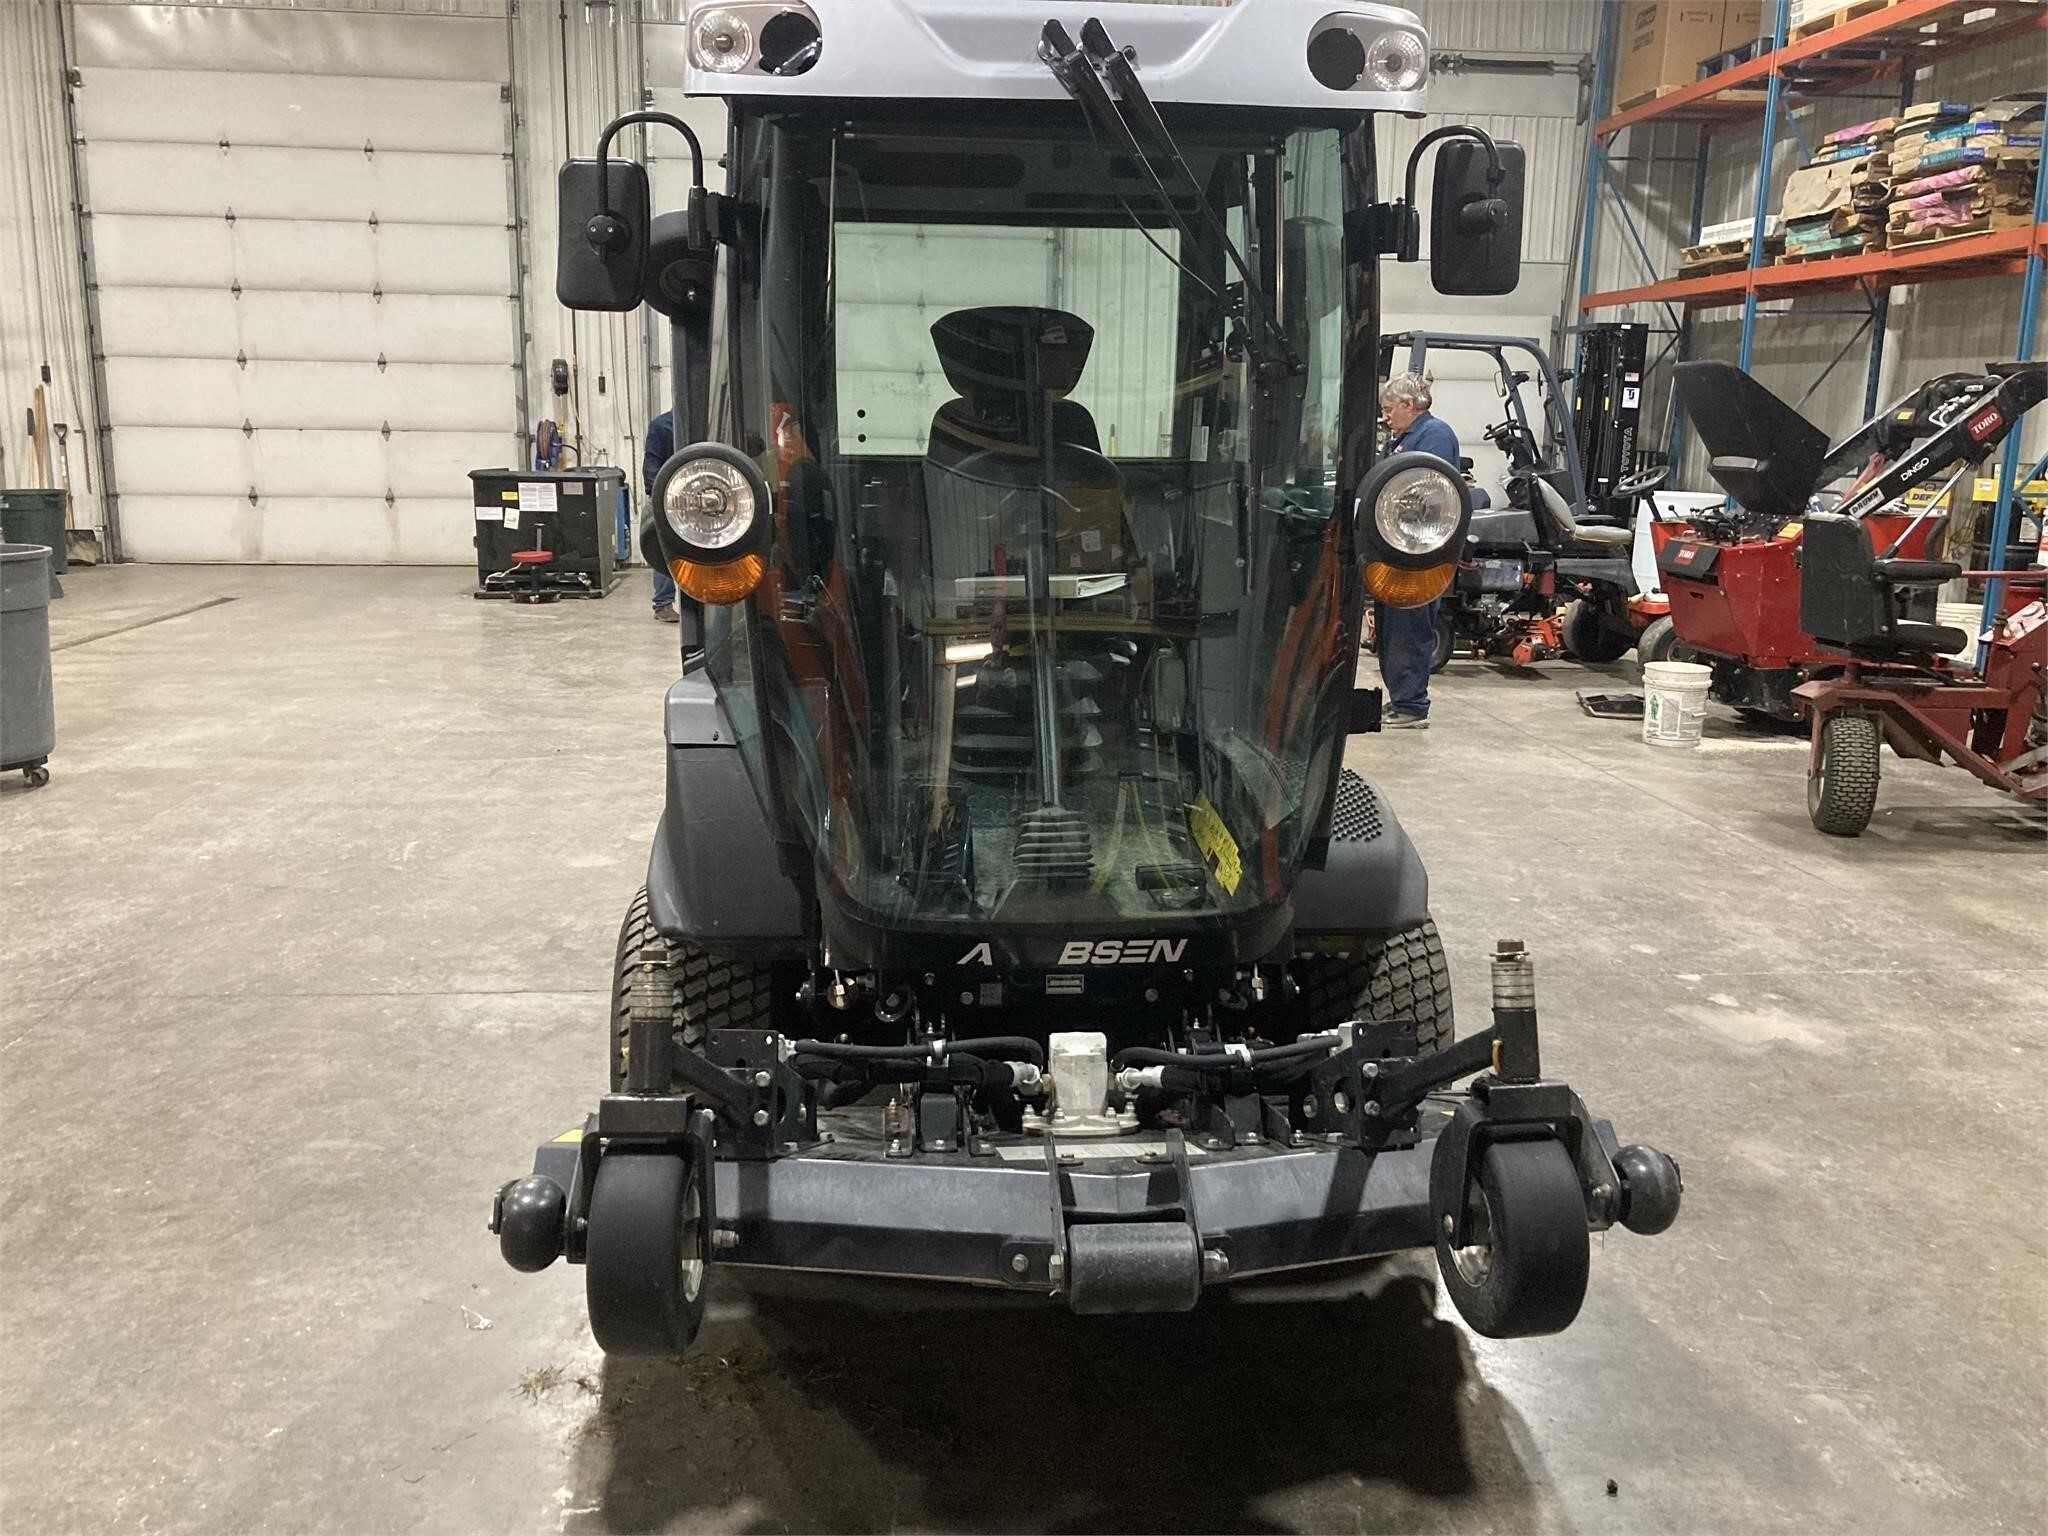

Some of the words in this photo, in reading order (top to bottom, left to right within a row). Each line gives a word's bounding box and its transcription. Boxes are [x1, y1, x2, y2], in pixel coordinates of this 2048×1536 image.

[1971, 412, 1998, 434] TORO
[1620, 426, 1633, 473] TOYOTA
[1900, 457, 1930, 481] DINGO
[1851, 490, 1880, 514] DRUMM
[1912, 493, 1933, 501] DEF
